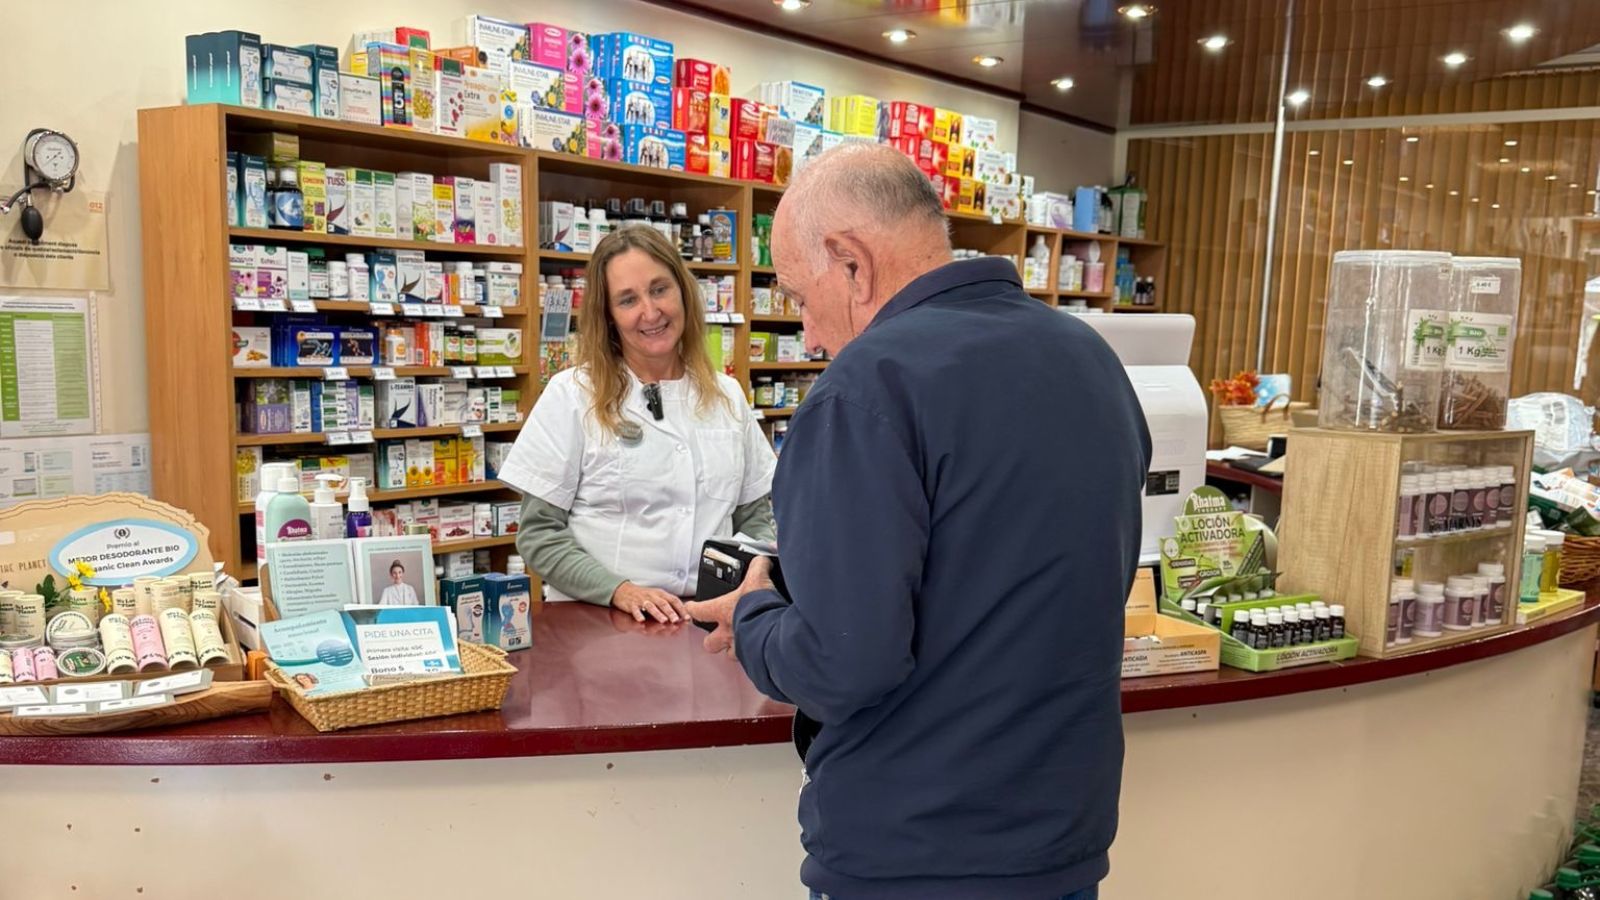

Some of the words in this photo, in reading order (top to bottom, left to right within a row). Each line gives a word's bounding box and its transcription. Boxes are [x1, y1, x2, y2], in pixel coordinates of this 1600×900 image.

[394, 91, 404, 109] 5
[464, 90, 480, 101] Extra
[1466, 346, 1481, 357] Kg
[1191, 515, 1231, 530] LOCIÓN
[1180, 528, 1246, 543] ACTIVADORA
[106, 542, 132, 550] Premio
[99, 547, 164, 562] DESODORANTE
[164, 544, 180, 553] BIO
[18, 559, 47, 571] PLANET
[116, 561, 141, 570] Clean
[141, 556, 174, 567] Awards
[363, 630, 388, 639] PIDE
[390, 629, 412, 638] UNA
[413, 627, 434, 636] CITA
[367, 653, 390, 661] Sesión
[1180, 649, 1207, 657] ANTICASPA
[370, 665, 397, 674] Bono
